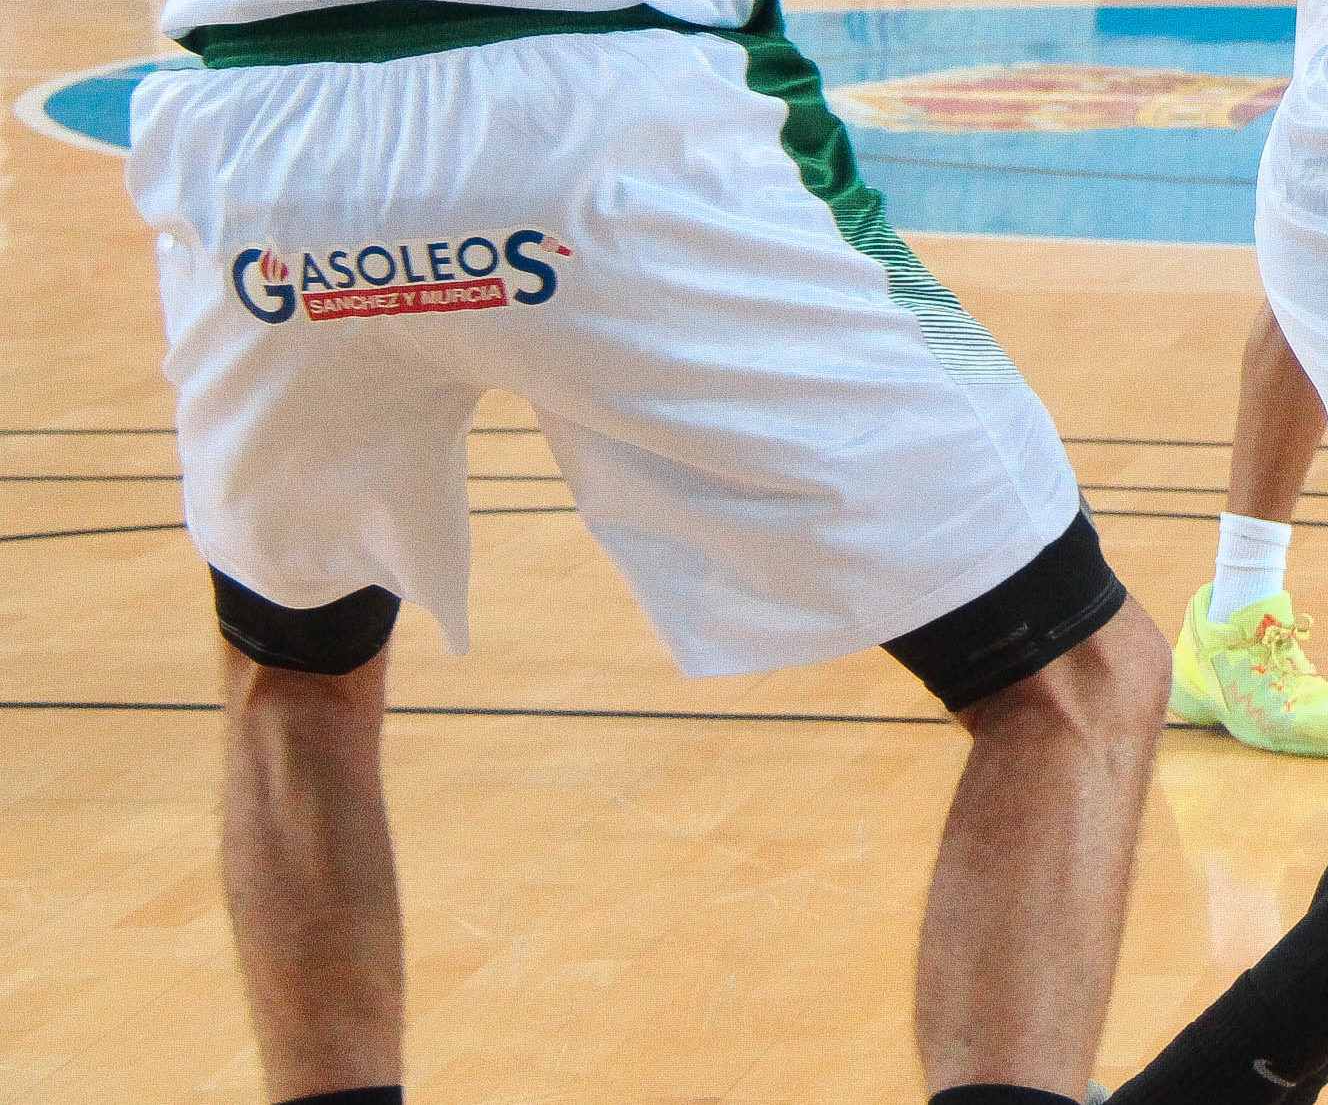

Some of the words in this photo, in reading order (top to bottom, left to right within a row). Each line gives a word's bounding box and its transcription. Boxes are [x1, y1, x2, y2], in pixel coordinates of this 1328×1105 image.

[231, 229, 560, 325] GASOLEOS
[309, 293, 400, 315] SANCHEZ
[402, 291, 415, 307] Y
[420, 285, 502, 306] MURCIA
